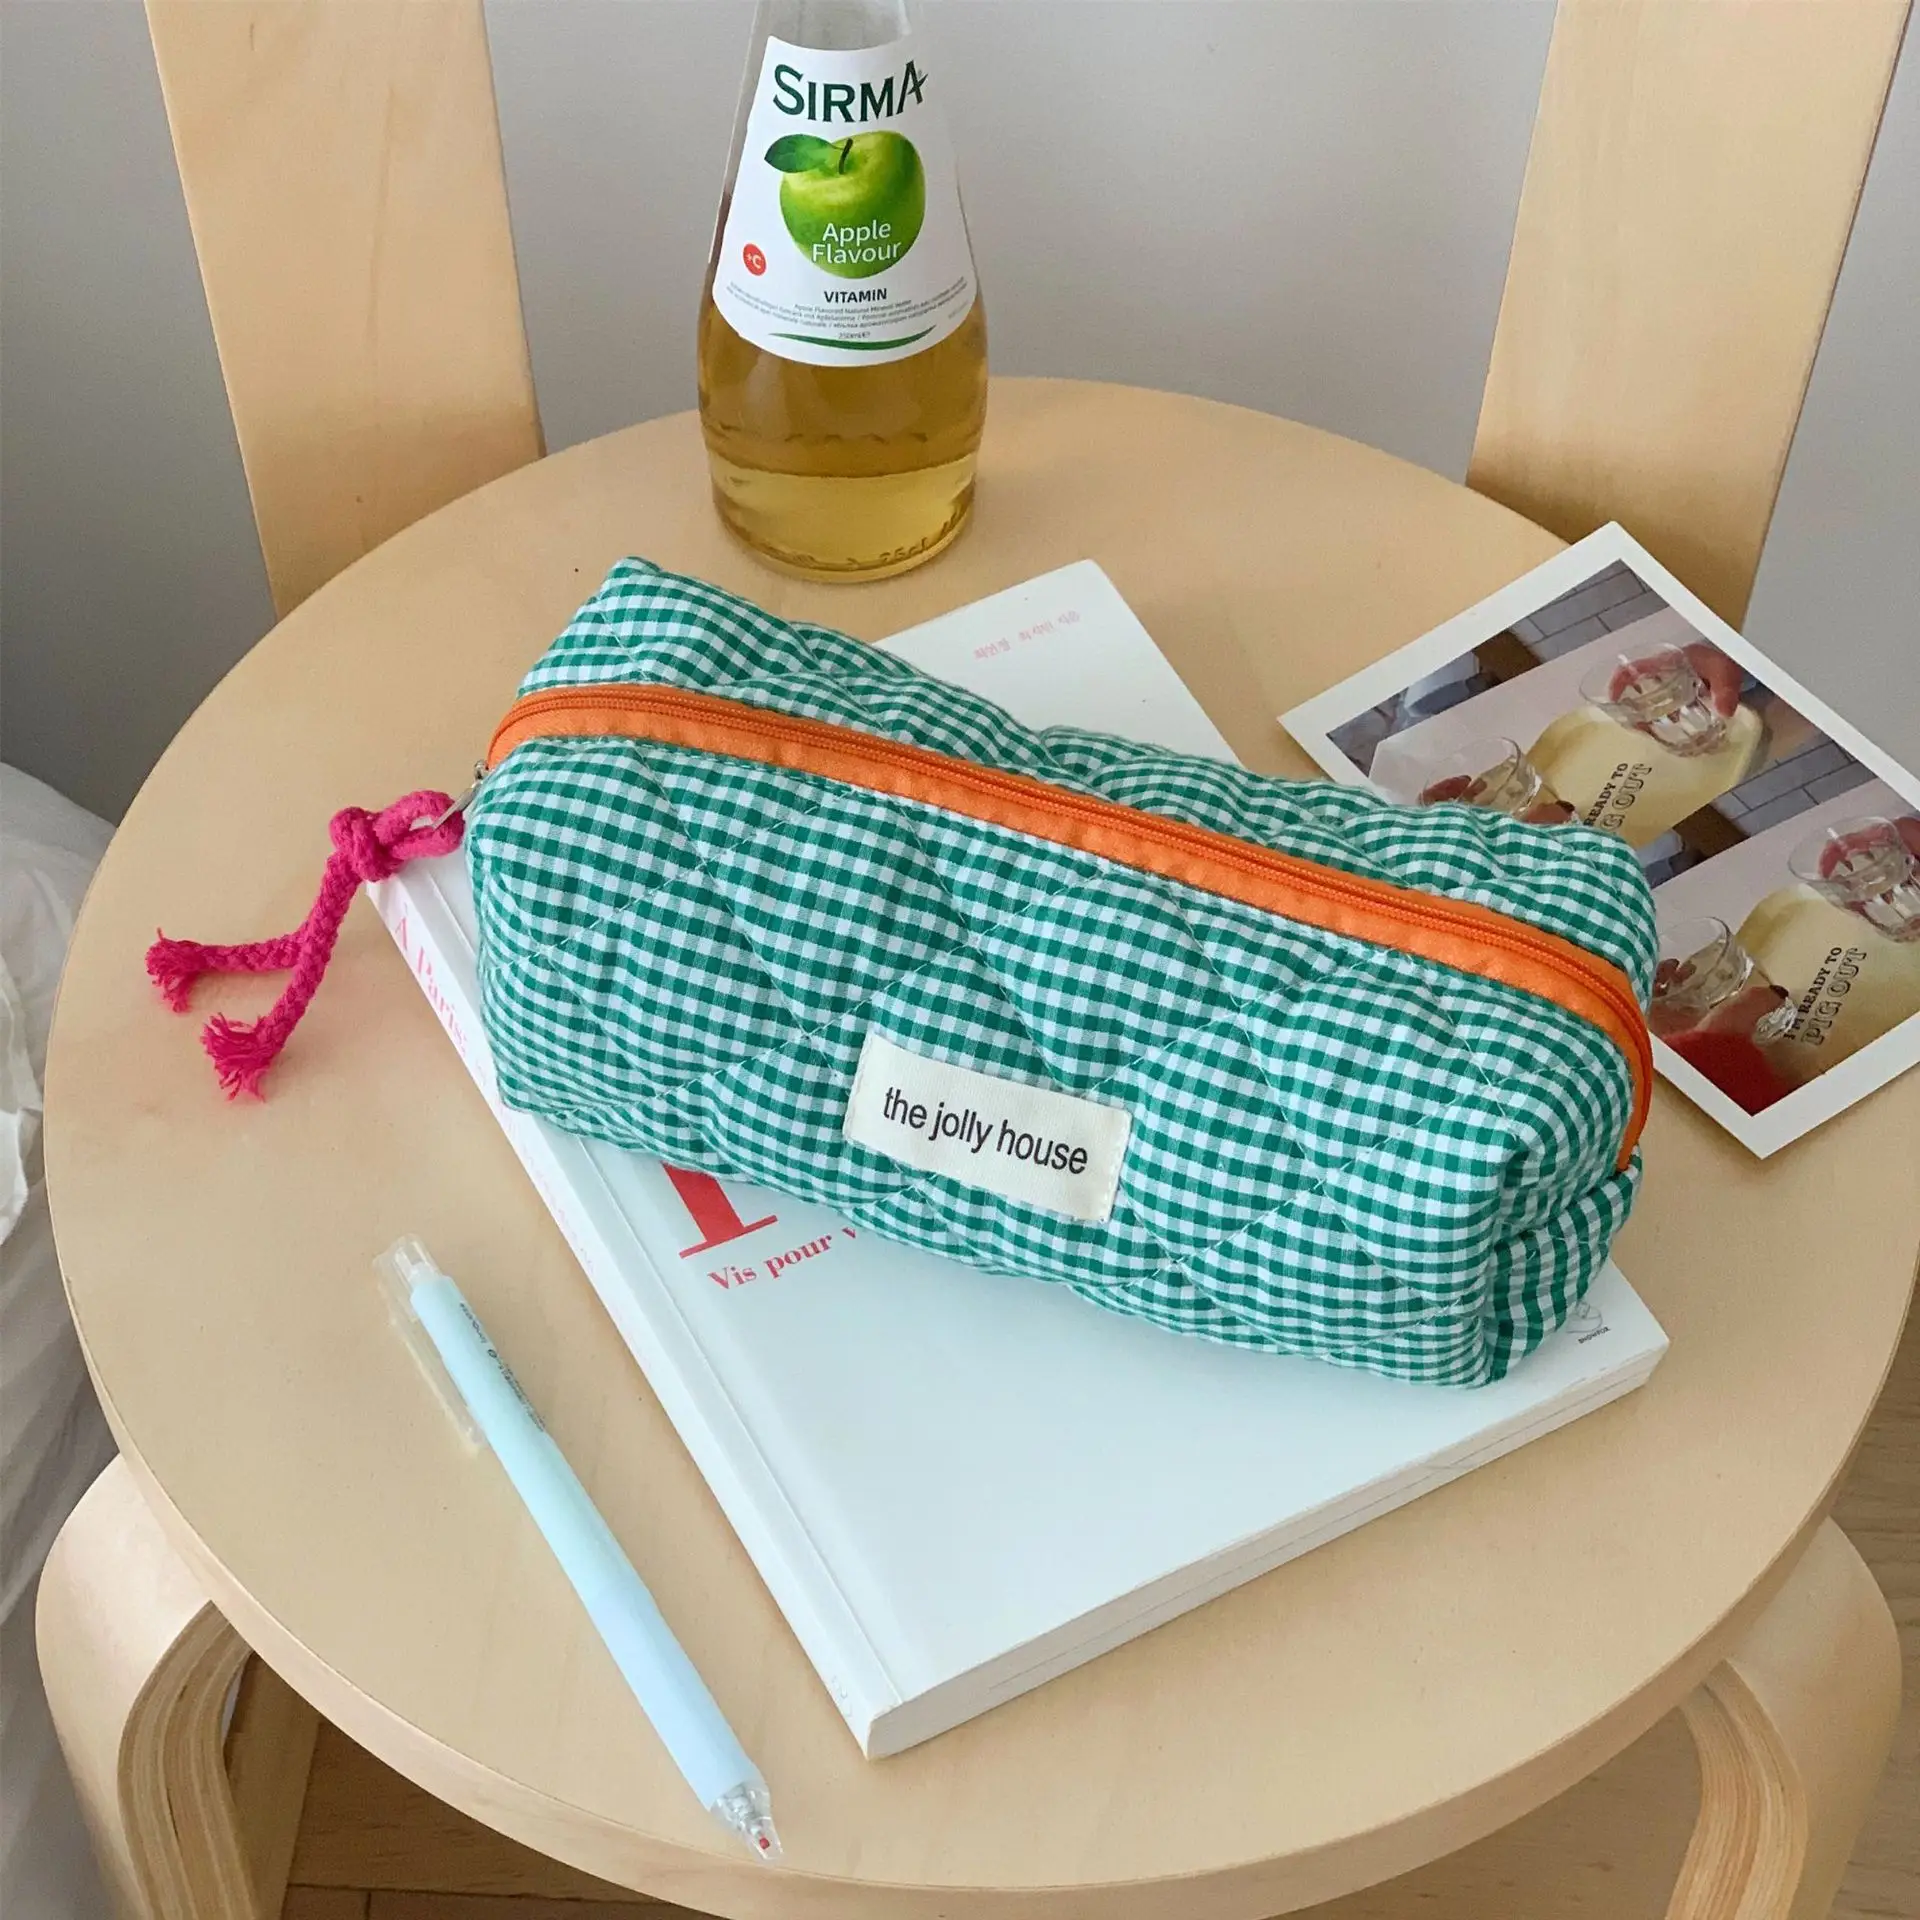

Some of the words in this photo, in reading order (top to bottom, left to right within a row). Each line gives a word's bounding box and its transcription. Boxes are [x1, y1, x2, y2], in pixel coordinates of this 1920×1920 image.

[772, 60, 929, 123] SIRMA
[812, 242, 902, 264] Flavour
[822, 219, 892, 248] Apple
[823, 288, 888, 304] VITAMIN
[1583, 782, 1616, 827] READY
[1611, 763, 1628, 780] TO
[1612, 763, 1652, 811] OUT
[1797, 967, 1831, 1014] READY
[1824, 946, 1843, 965] TO
[1801, 1000, 1843, 1046] PIG
[1826, 947, 1867, 998] OUT
[883, 1086, 928, 1130] the
[928, 1101, 994, 1154] jolly
[996, 1118, 1089, 1175] house
[707, 1265, 758, 1290] Vis
[763, 1234, 833, 1279] pour
